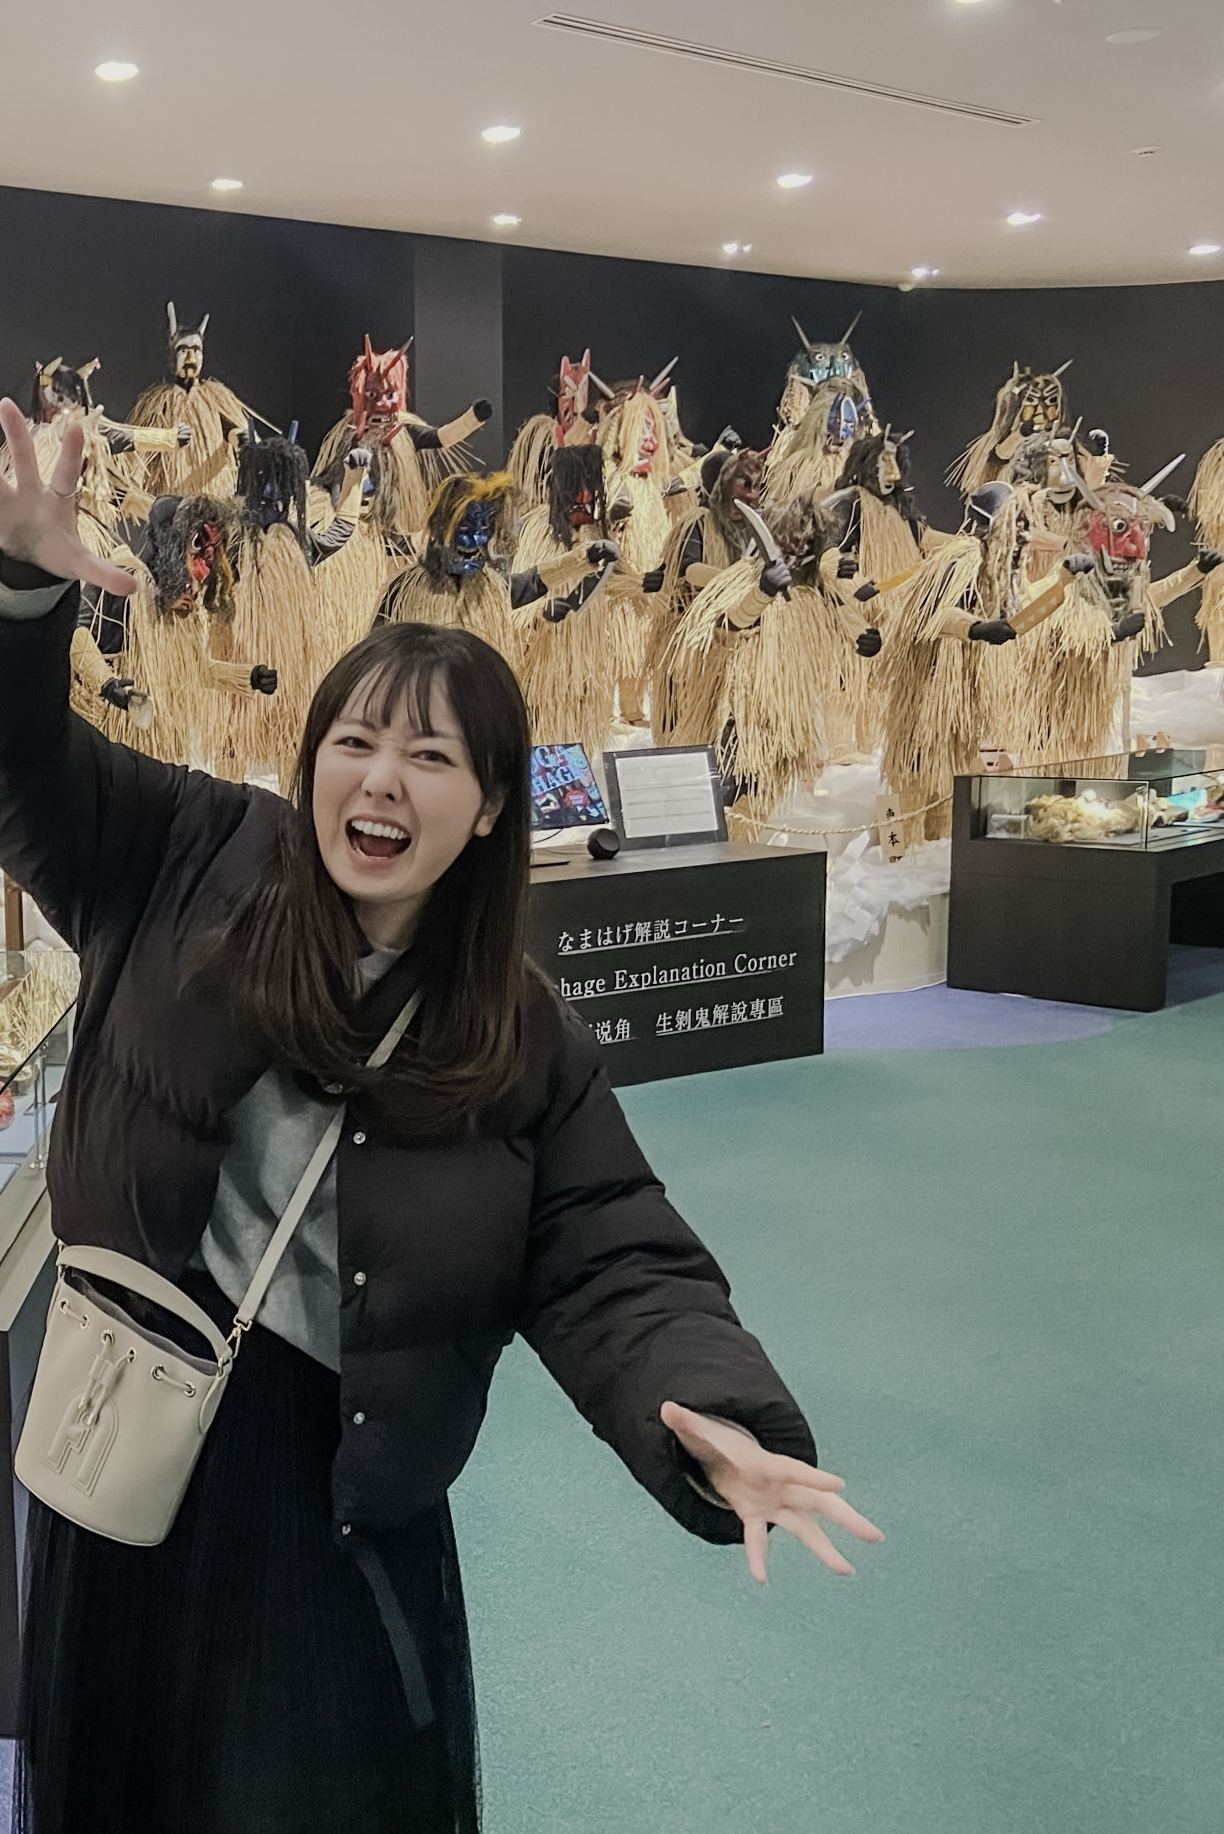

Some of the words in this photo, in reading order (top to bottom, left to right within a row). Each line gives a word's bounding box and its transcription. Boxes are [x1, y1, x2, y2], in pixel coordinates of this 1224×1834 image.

[558, 914, 744, 952] なまはげ解説コーナー
[560, 977, 606, 998] hage
[614, 958, 726, 990] Explanation
[734, 952, 797, 974] Corner
[588, 1017, 631, 1042] 说角
